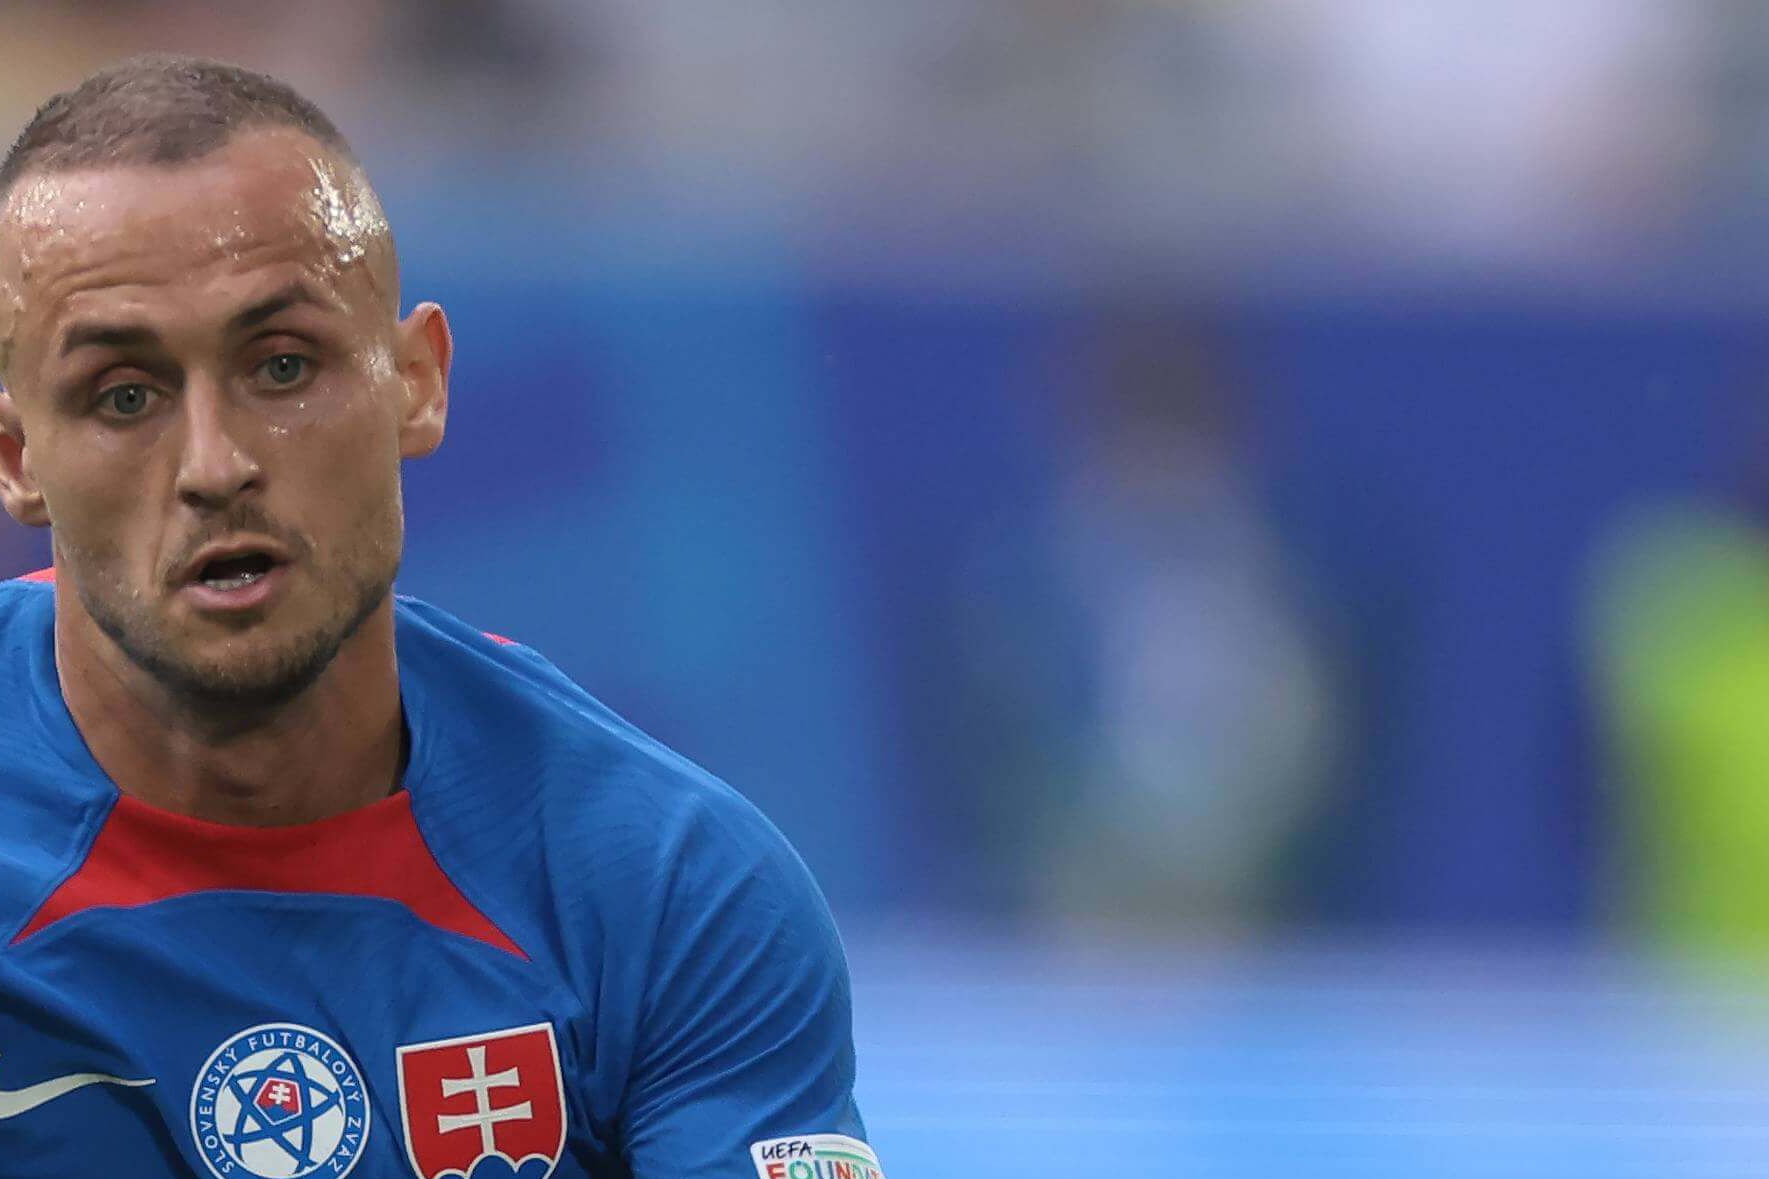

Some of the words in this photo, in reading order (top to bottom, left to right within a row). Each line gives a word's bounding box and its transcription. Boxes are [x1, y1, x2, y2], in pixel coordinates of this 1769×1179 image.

[198, 1047, 238, 1174] SLOVENSKÝ
[247, 1032, 363, 1102] FUTBALOVÝ
[762, 1140, 812, 1160] UEFA
